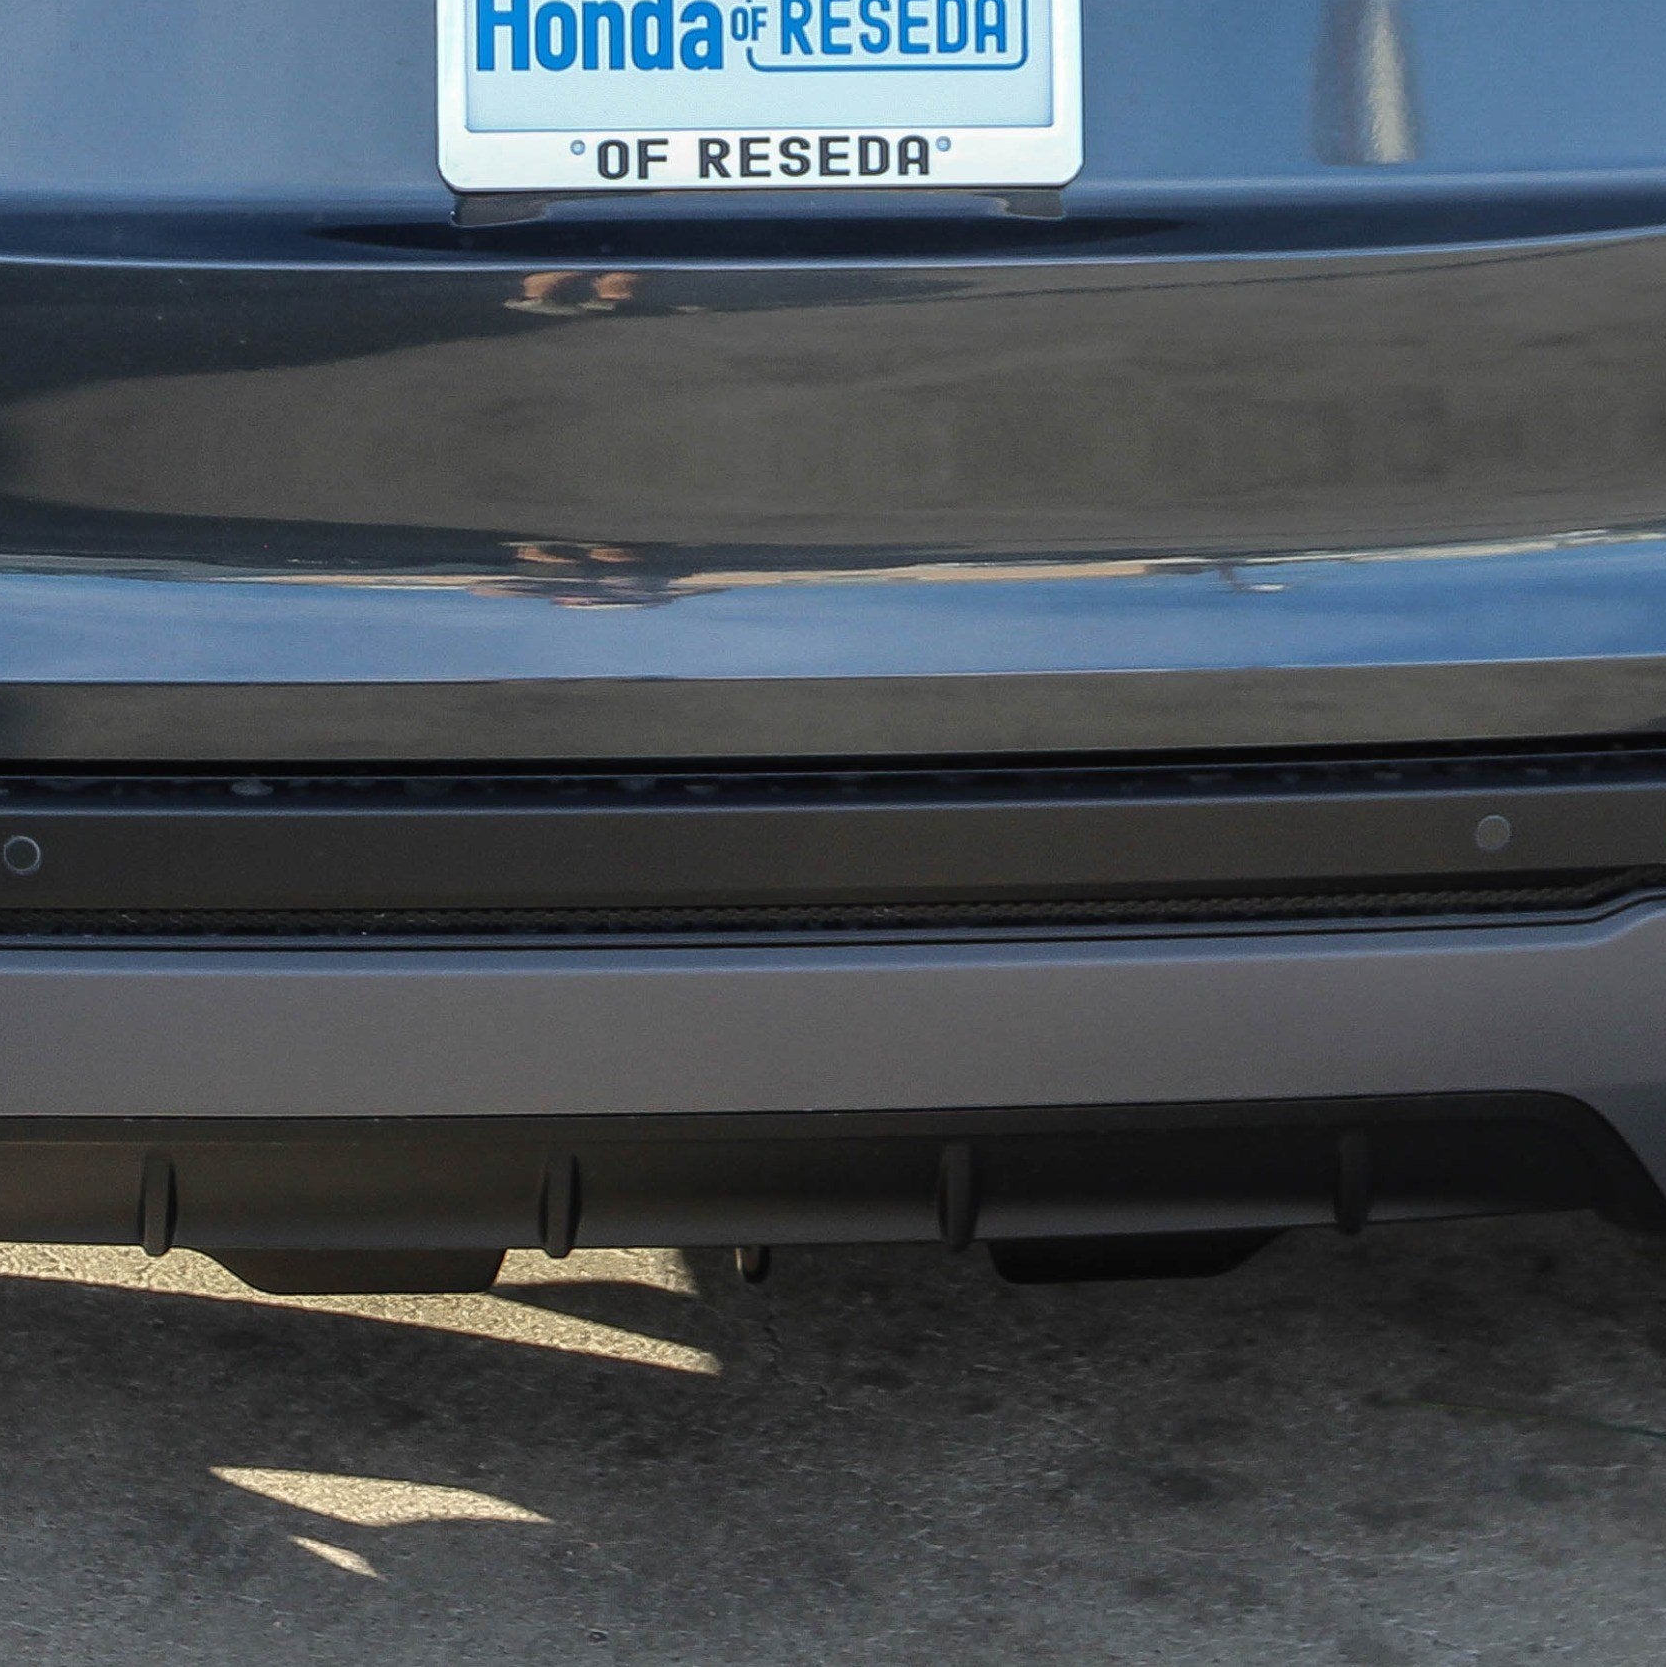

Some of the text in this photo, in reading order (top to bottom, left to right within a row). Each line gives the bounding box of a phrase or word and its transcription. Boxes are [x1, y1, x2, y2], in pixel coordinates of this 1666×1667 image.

[731, 5, 768, 42] OF
[596, 134, 930, 181] OF RESEDA
